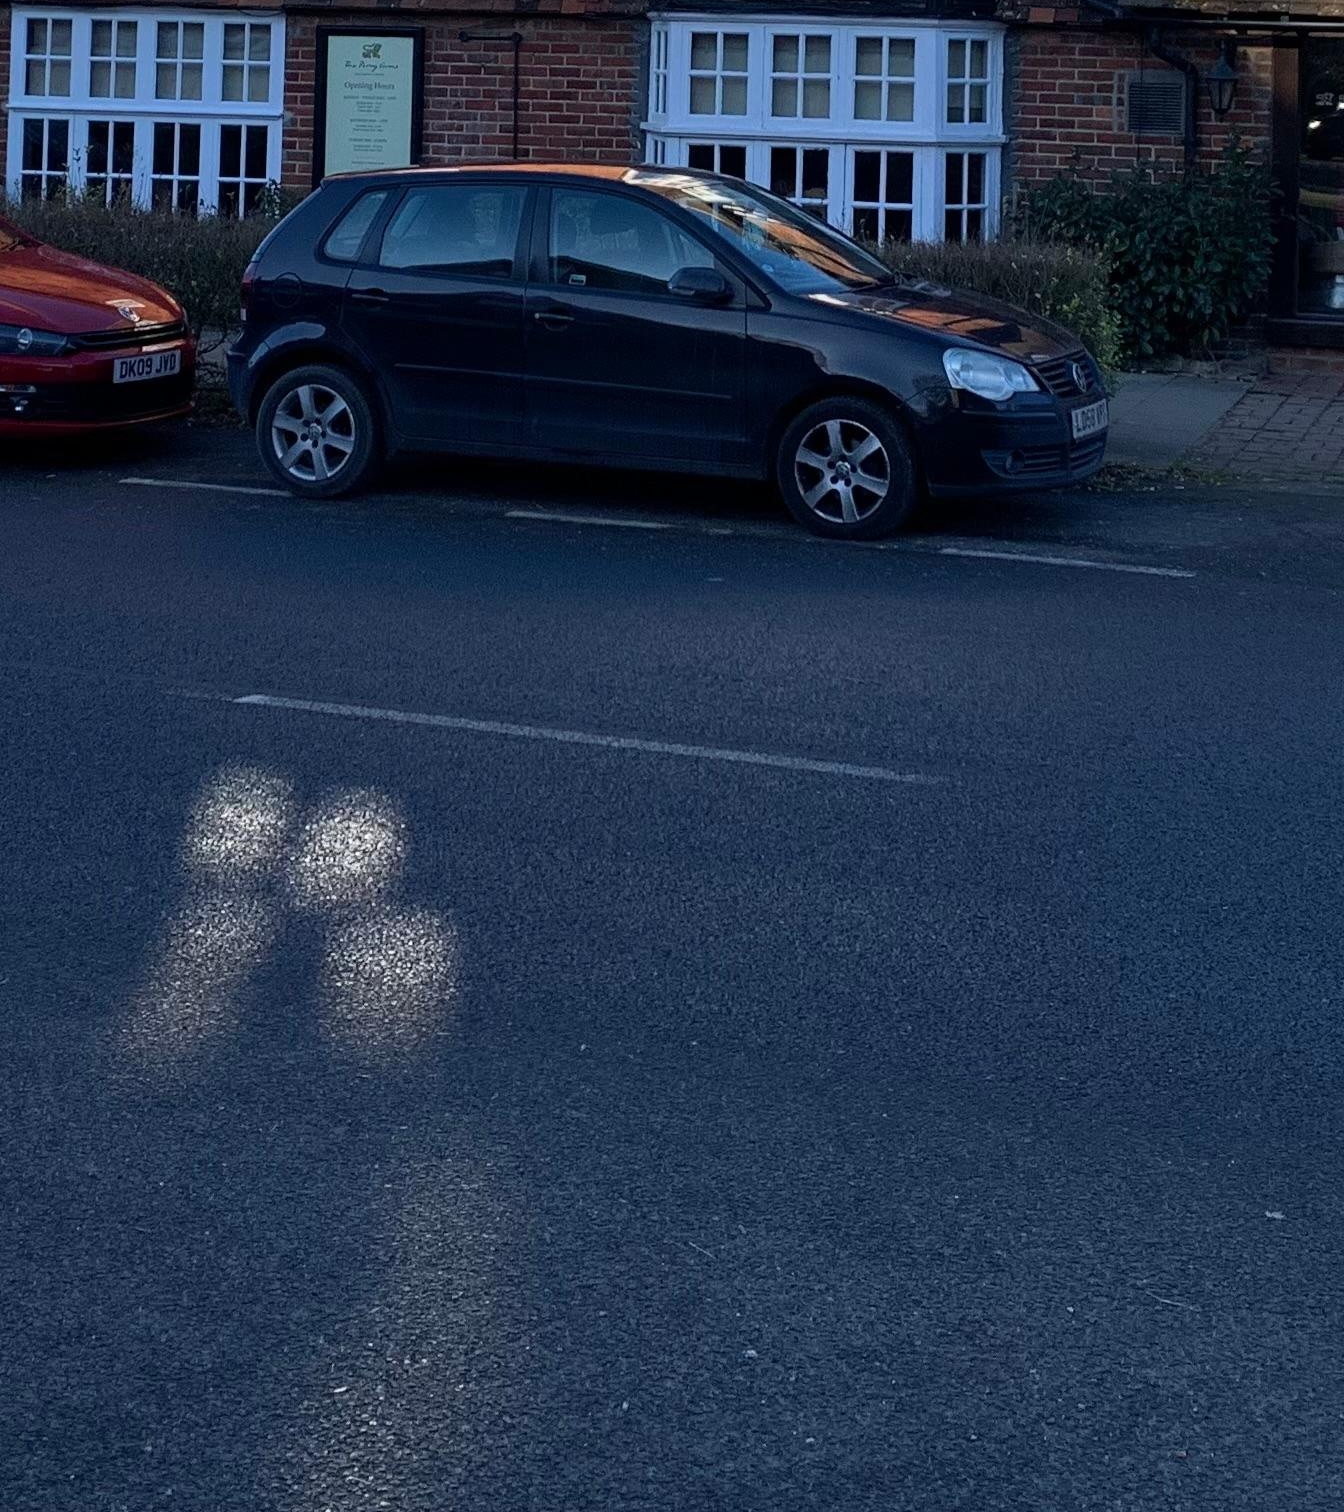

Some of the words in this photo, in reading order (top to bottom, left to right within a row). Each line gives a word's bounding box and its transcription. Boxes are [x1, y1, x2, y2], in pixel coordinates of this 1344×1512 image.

[343, 81, 373, 91] Opening
[374, 81, 395, 90] Hours
[119, 357, 153, 379] DK09
[155, 352, 177, 373] JVD
